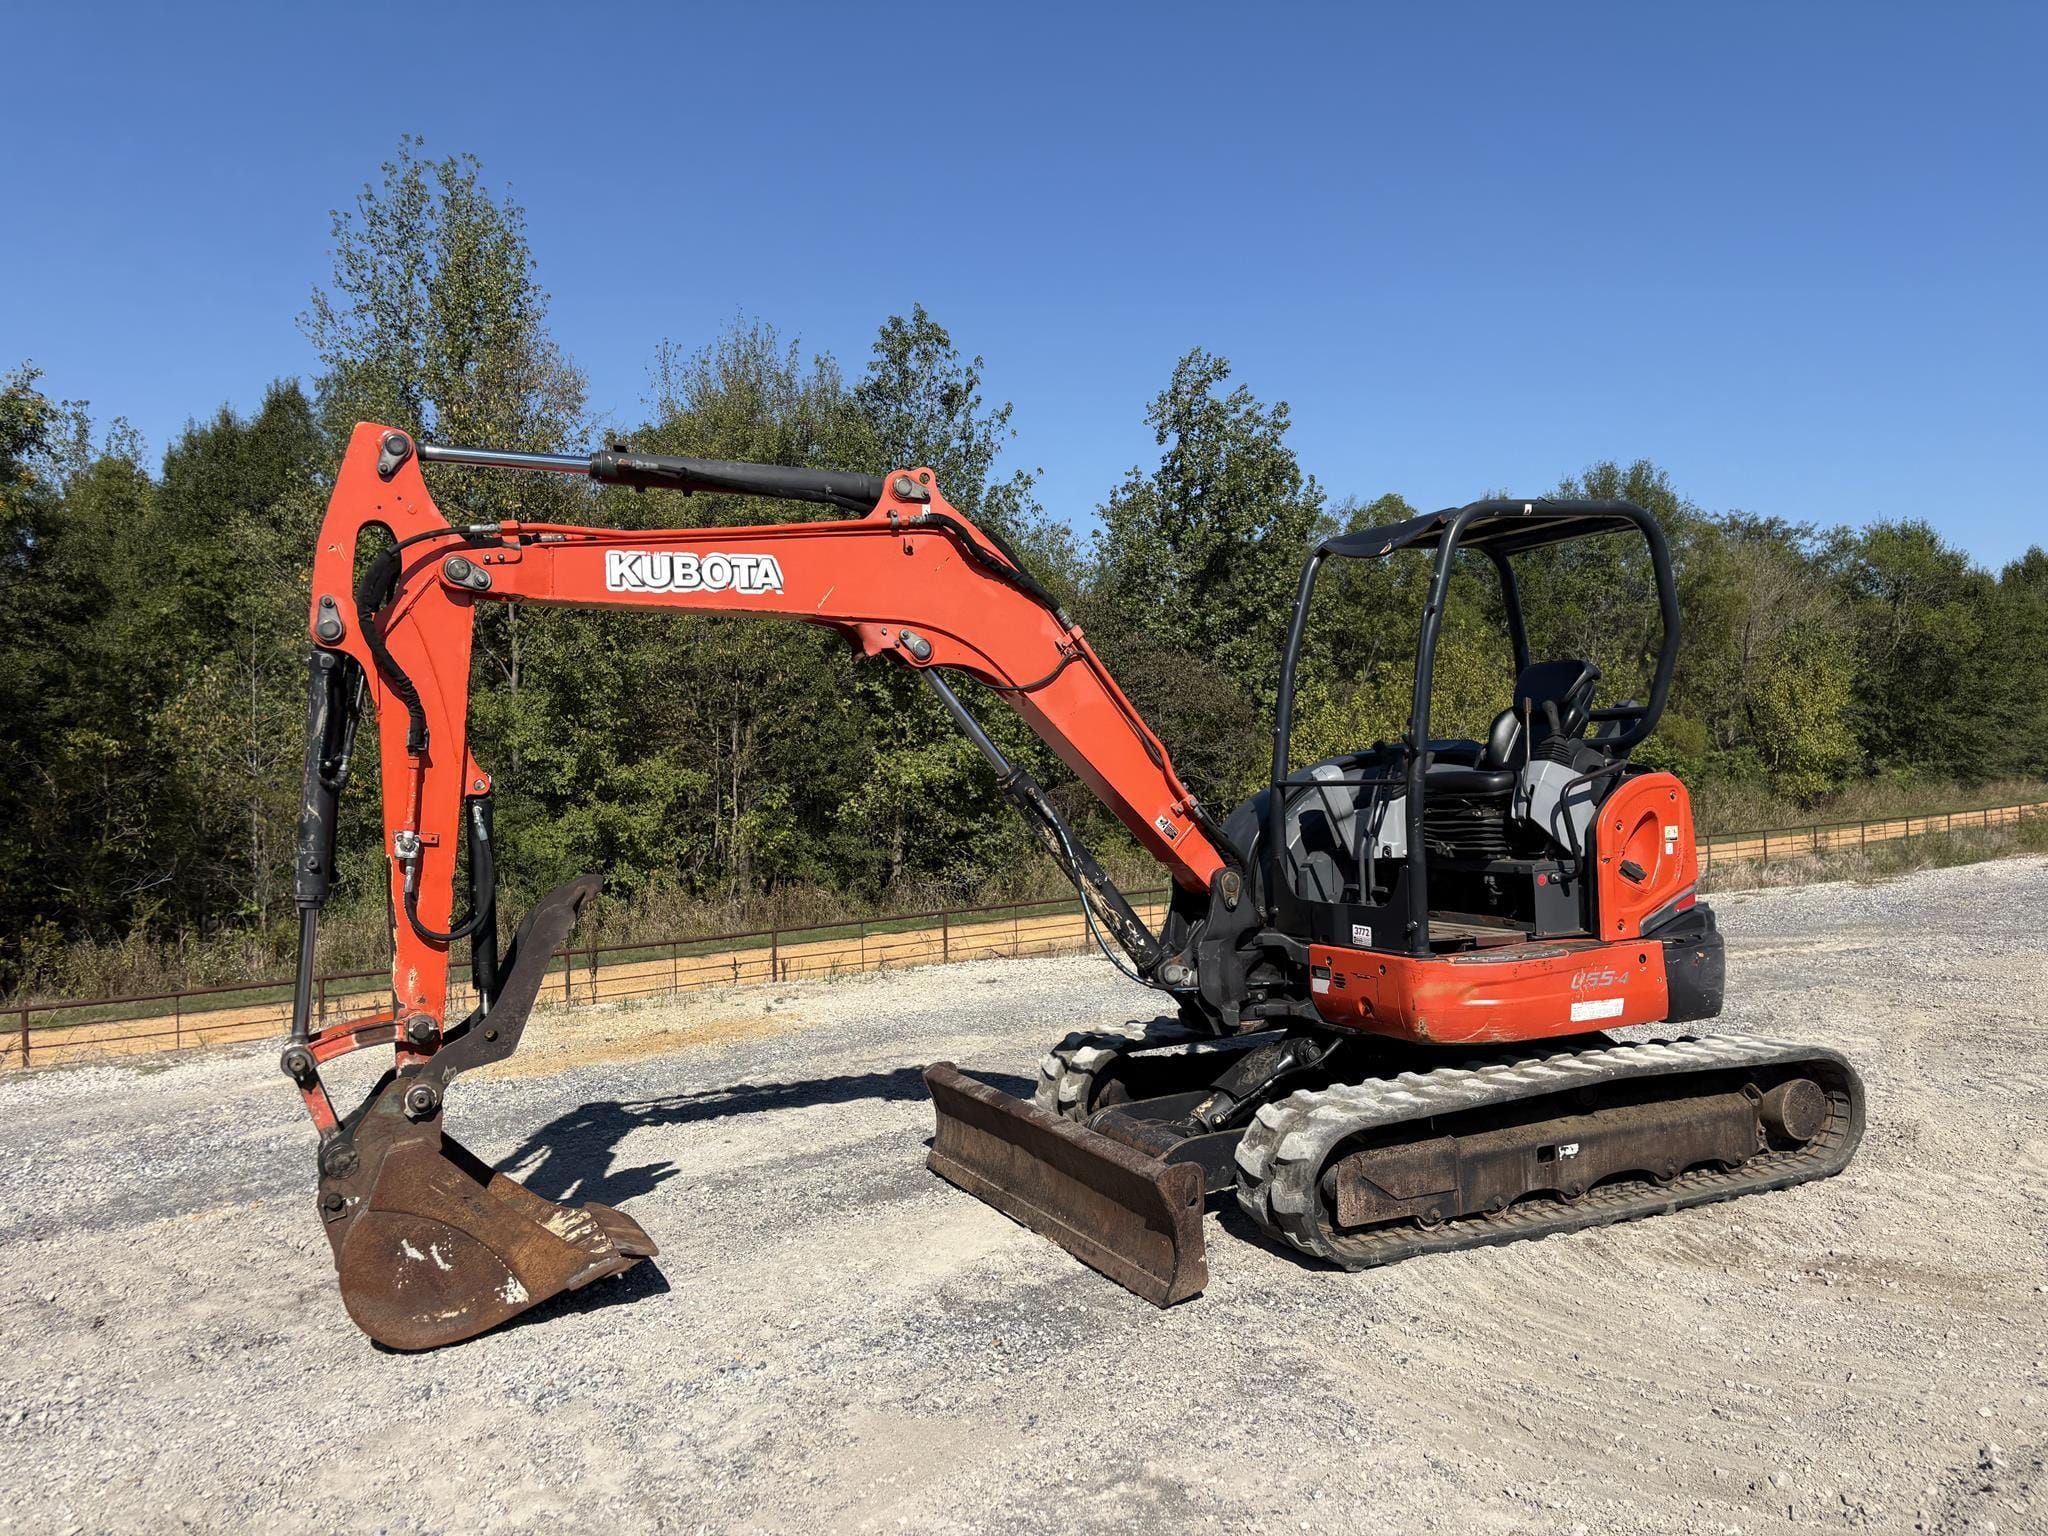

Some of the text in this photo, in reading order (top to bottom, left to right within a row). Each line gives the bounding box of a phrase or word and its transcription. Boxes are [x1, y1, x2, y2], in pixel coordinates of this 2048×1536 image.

[608, 552, 783, 591] KUBOTA
[1354, 926, 1370, 937] 3772
[1571, 970, 1629, 990] U55-4
